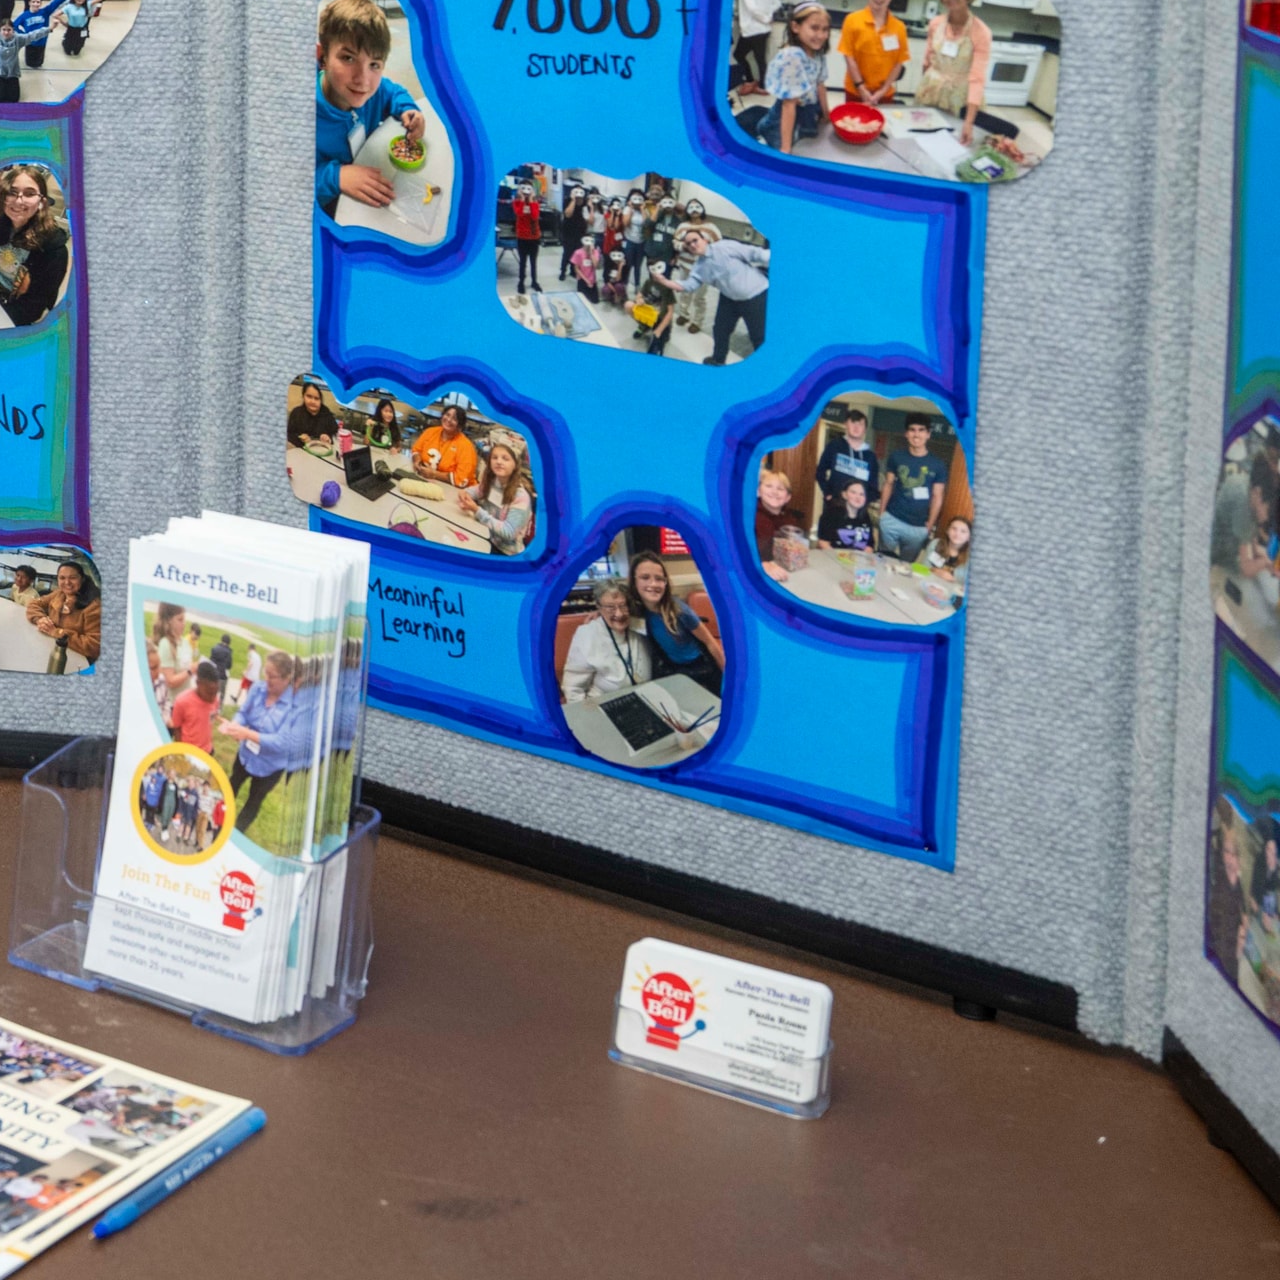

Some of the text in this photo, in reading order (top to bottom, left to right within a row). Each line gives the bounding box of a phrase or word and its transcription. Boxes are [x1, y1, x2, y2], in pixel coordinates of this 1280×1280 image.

[527, 53, 634, 81] STUDENTS
[153, 563, 279, 605] After-The-Bell
[381, 608, 465, 658] Learning
[121, 864, 212, 903] Join The Fun
[223, 891, 252, 910] Bell
[644, 978, 693, 1004] After
[647, 998, 687, 1023] Bell
